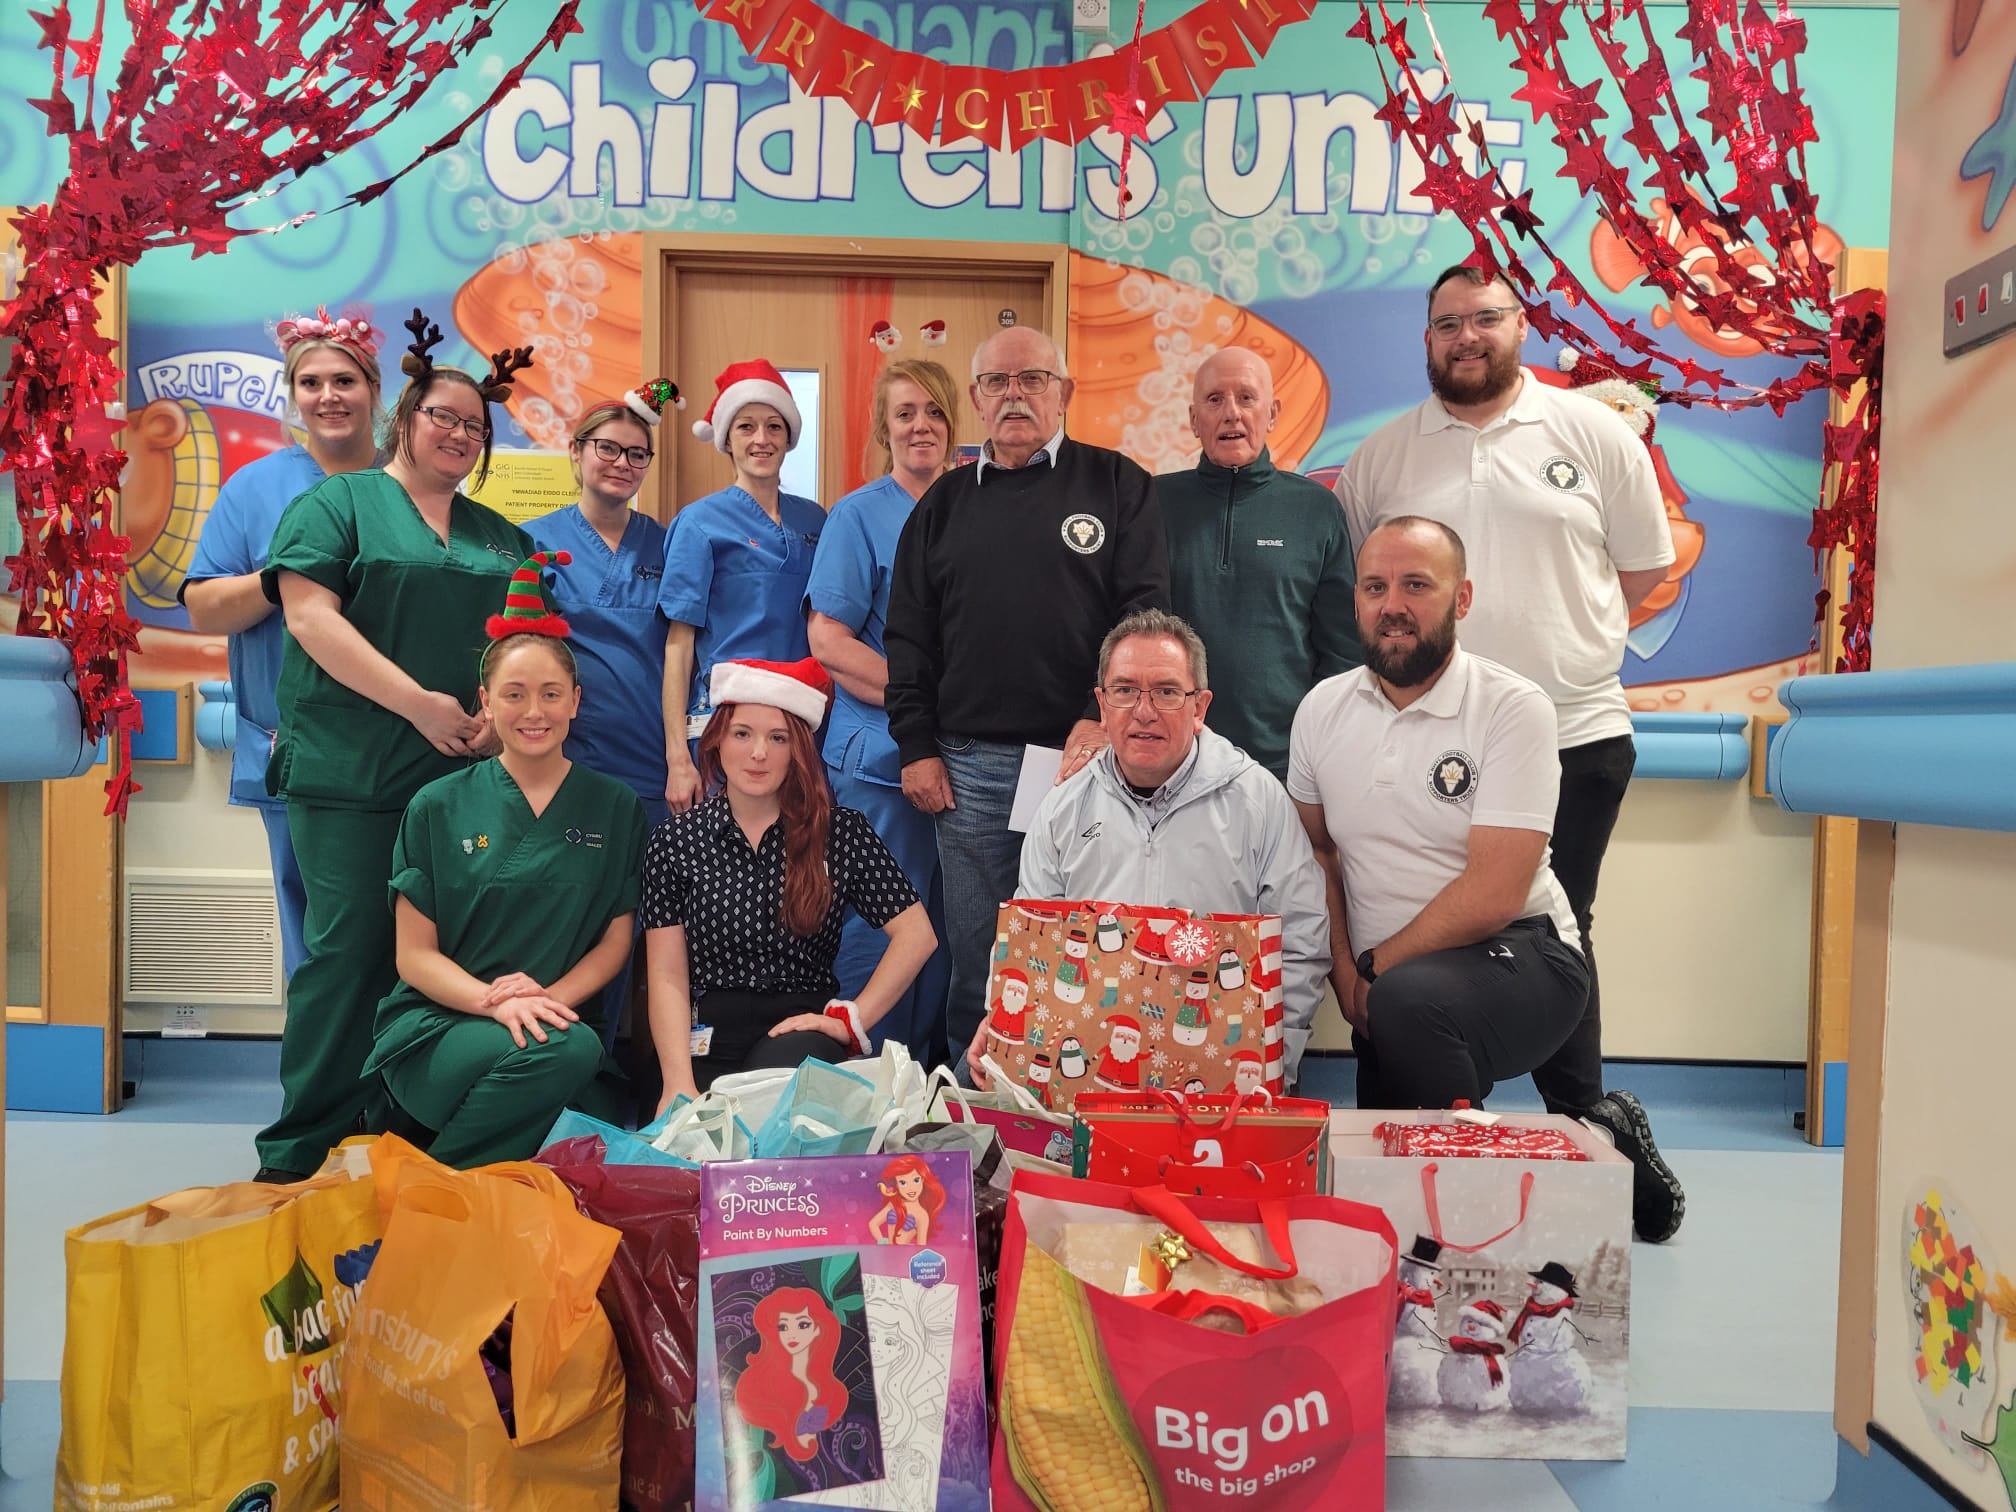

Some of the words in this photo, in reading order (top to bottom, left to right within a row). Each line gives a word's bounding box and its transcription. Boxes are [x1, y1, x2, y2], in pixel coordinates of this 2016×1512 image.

[719, 1193, 819, 1223] PRINCESS
[723, 1229, 754, 1241] Paint
[756, 1228, 773, 1241] By
[775, 1226, 828, 1239] Numbers
[264, 1324, 288, 1362] a
[1155, 1405, 1248, 1472] Big
[1261, 1390, 1330, 1443] on
[283, 1436, 300, 1475] &
[1174, 1467, 1214, 1492] the
[1219, 1477, 1258, 1496] big
[1263, 1455, 1317, 1486] shop
